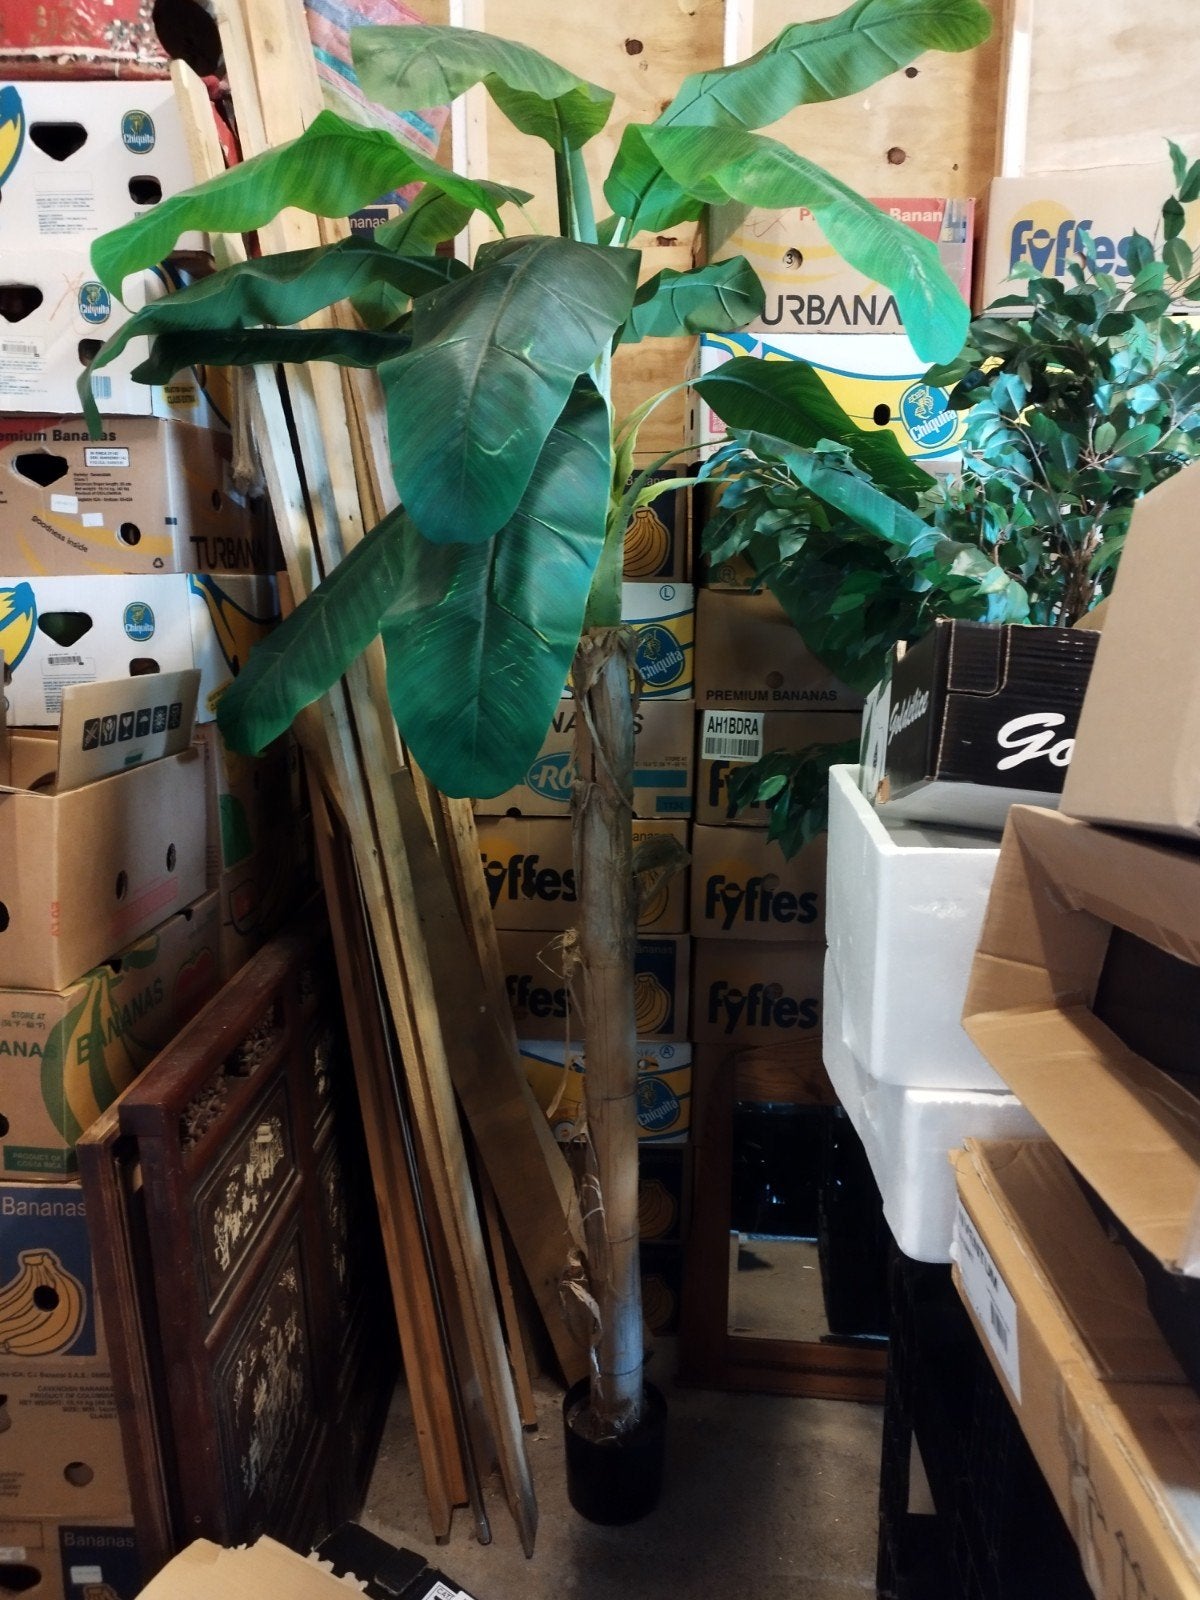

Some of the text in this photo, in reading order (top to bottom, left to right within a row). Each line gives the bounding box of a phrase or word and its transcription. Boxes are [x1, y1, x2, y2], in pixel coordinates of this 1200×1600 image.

[123, 133, 155, 147] Chiquita
[786, 253, 794, 265] 3
[79, 303, 110, 317] Chiquita
[52, 429, 117, 442] Banaas
[909, 409, 958, 442] Chiquita
[31, 515, 89, 553] goodness inside
[639, 649, 684, 681] Chiquita
[705, 689, 838, 702] PREMIUM BANANAS
[706, 716, 759, 736] AH1BDRA
[480, 853, 577, 910] yffes
[705, 874, 818, 930] fyffes
[708, 980, 819, 1034] fyffes
[638, 1098, 679, 1127] Chiquita
[1, 1195, 88, 1217] Bananas
[63, 1531, 136, 1548] Bananas
